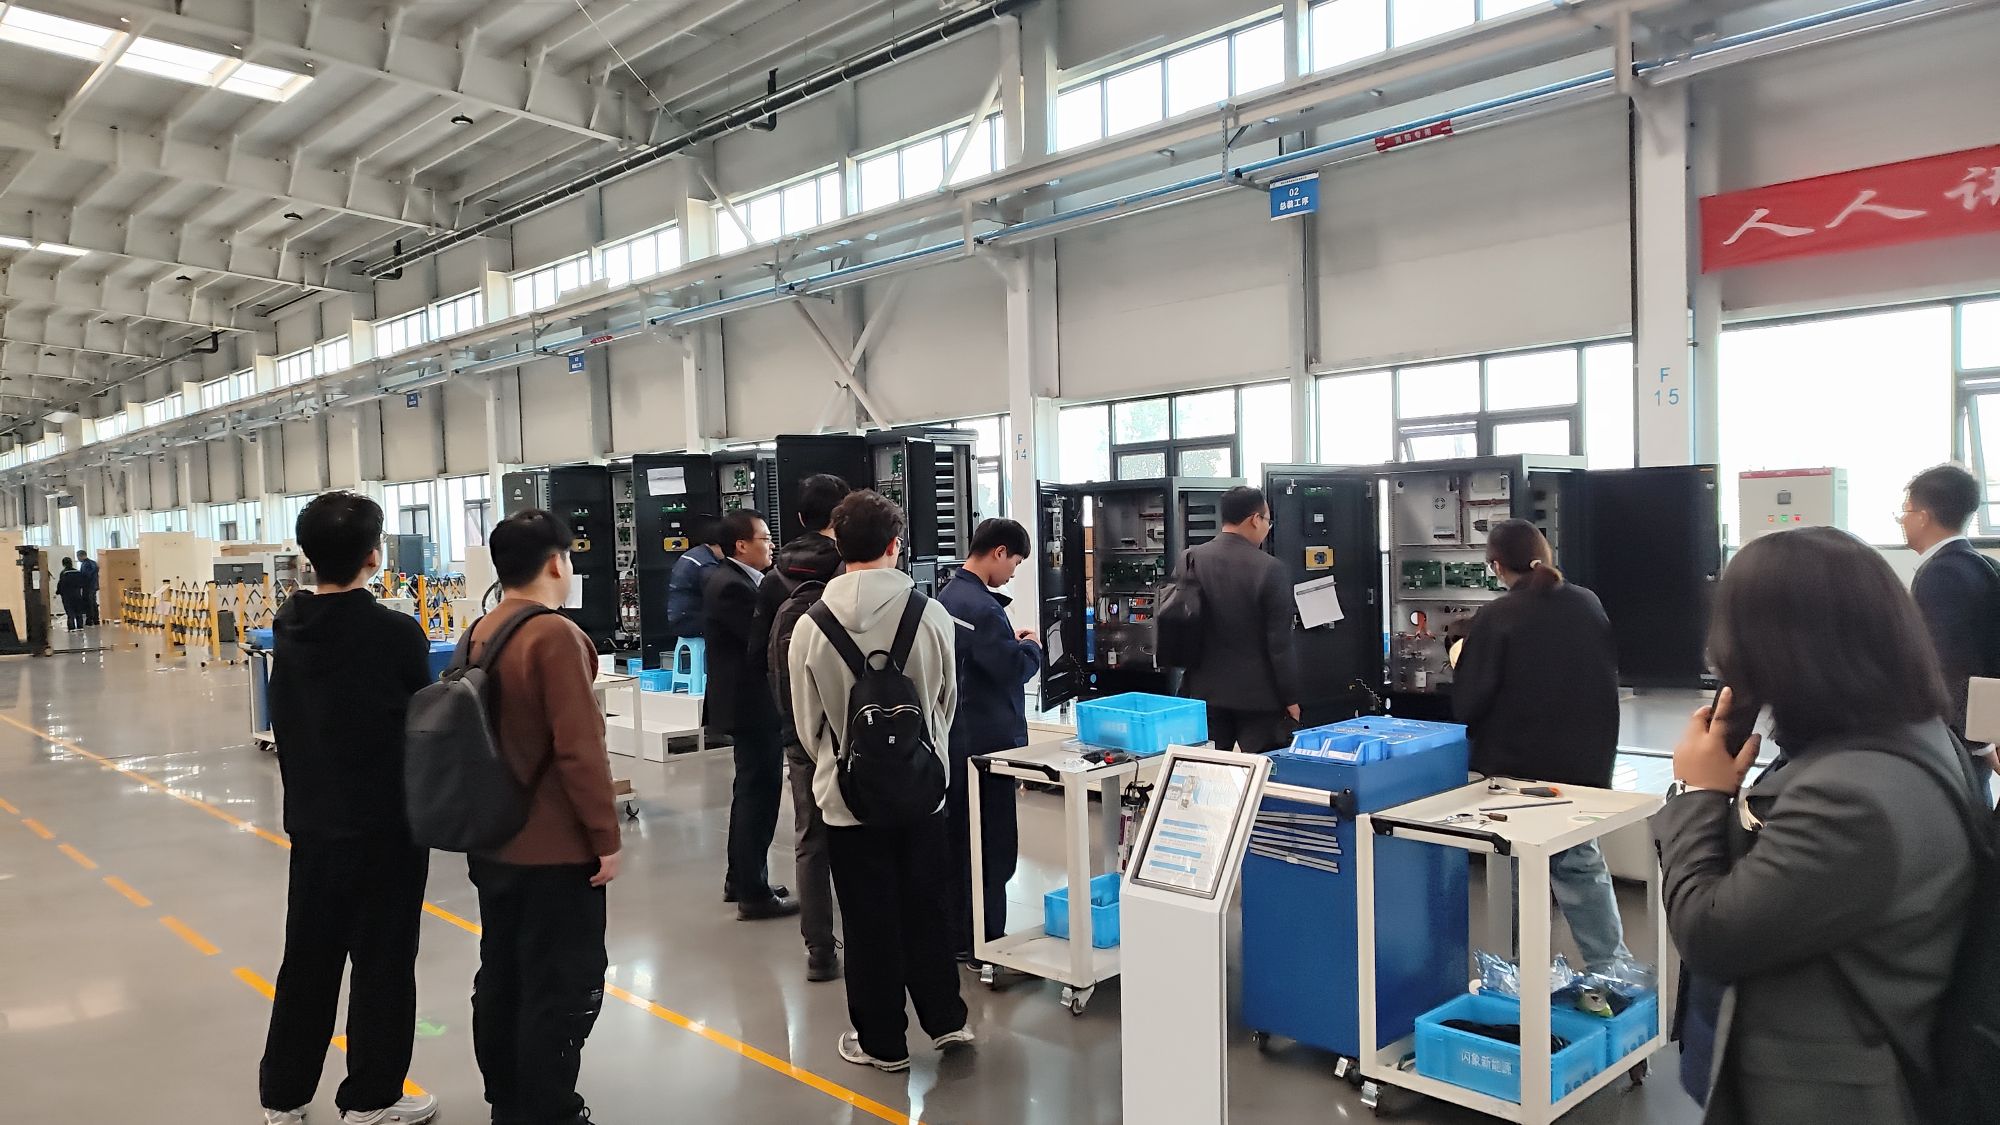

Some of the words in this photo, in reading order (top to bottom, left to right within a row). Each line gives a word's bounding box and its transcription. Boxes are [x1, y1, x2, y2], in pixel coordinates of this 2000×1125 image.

[1289, 187, 1300, 197] 02
[1660, 367, 1671, 383] F
[1654, 388, 1680, 406] 15
[1017, 433, 1024, 445] F
[1015, 448, 1027, 461] 14
[1461, 1050, 1513, 1076] 闪象新能源
